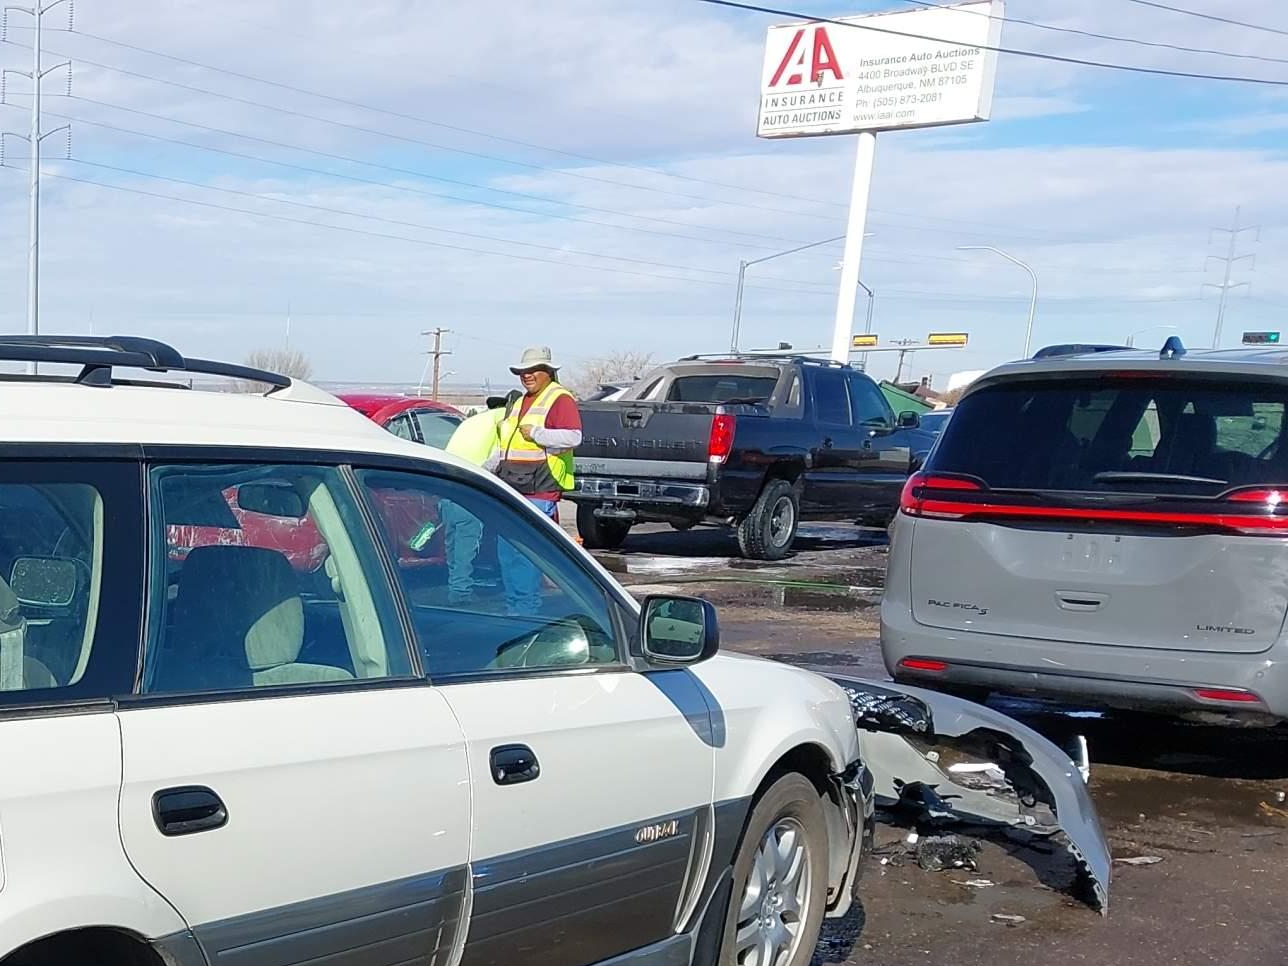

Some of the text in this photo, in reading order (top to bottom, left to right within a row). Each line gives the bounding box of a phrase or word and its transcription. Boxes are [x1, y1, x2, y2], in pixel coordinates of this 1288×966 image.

[859, 47, 980, 67] Insurance Auto Auctions
[858, 60, 974, 80] 4400 Broadway BLVD SE
[919, 78, 936, 88] NM
[938, 75, 968, 86] 87105
[765, 91, 844, 108] INSURANCE
[873, 97, 897, 109] (505)
[899, 92, 943, 105] 873-2081
[763, 109, 842, 126] AUTO AUCTIONS
[582, 436, 703, 449] HEVROLET
[928, 599, 980, 610] PACFICA
[1196, 624, 1255, 634] LIMITED
